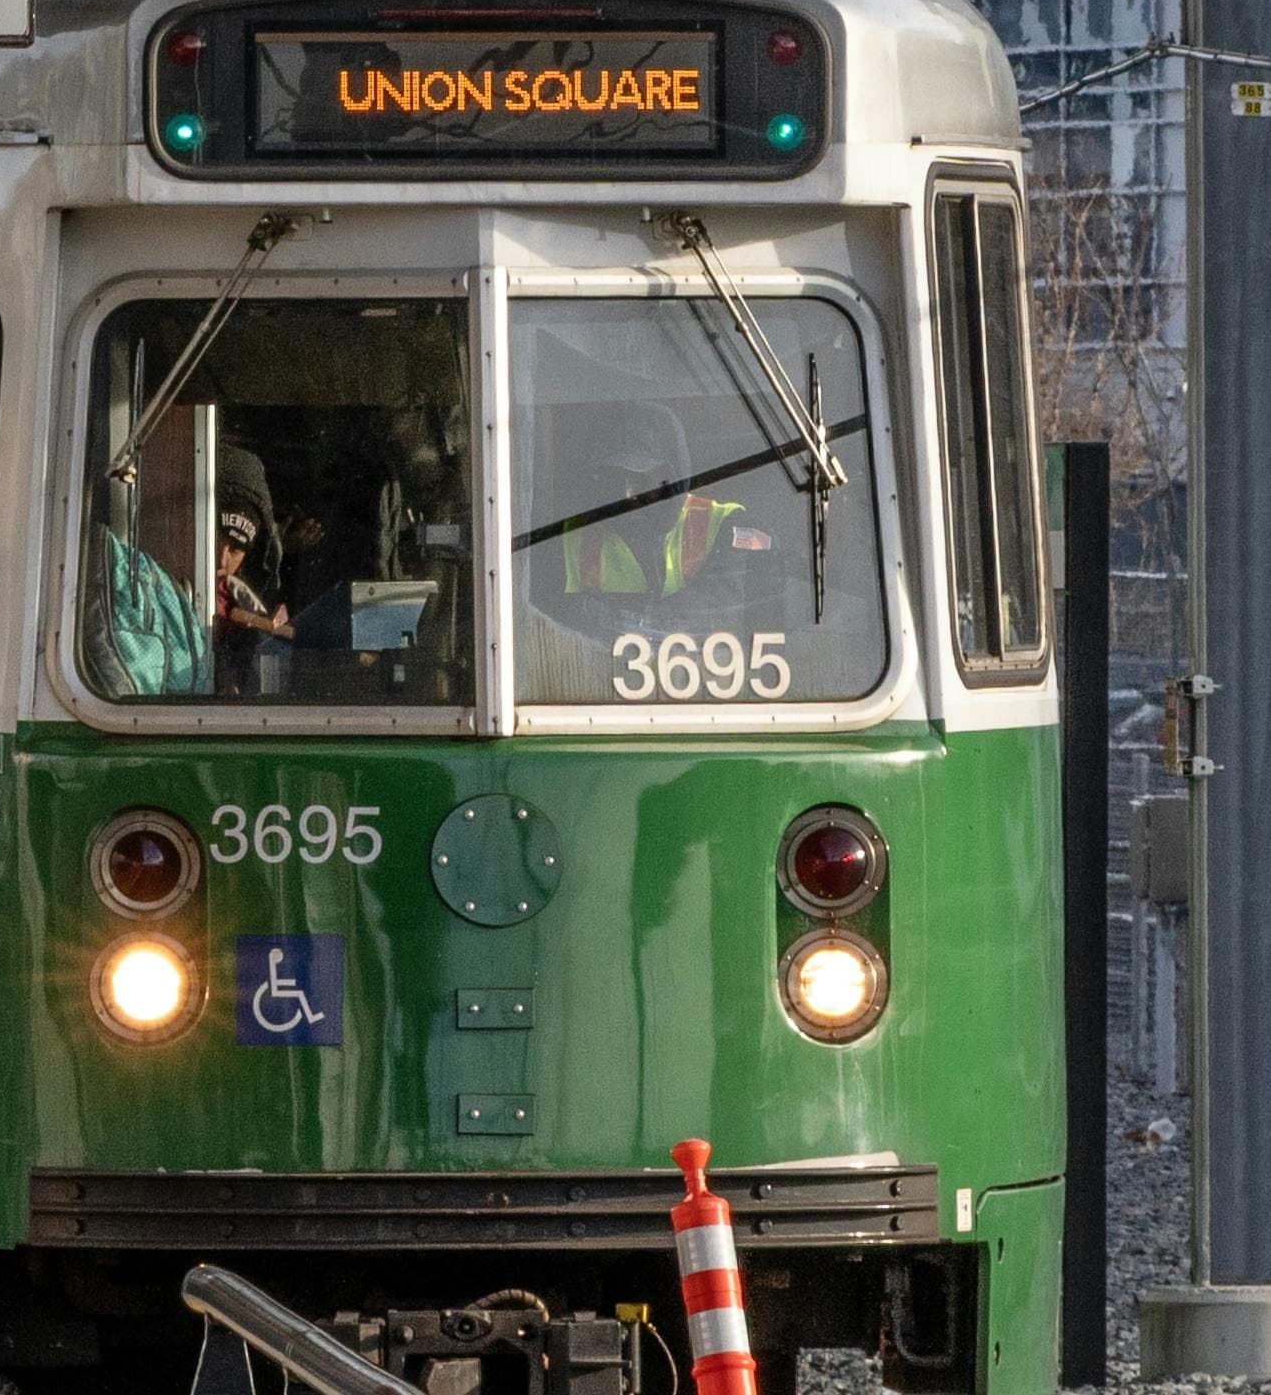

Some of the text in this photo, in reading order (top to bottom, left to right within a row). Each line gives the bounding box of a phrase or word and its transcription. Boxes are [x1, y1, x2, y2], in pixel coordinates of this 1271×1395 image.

[339, 70, 700, 112] UNION SQUARE
[612, 632, 791, 700] 3695
[209, 804, 383, 864] 3695
